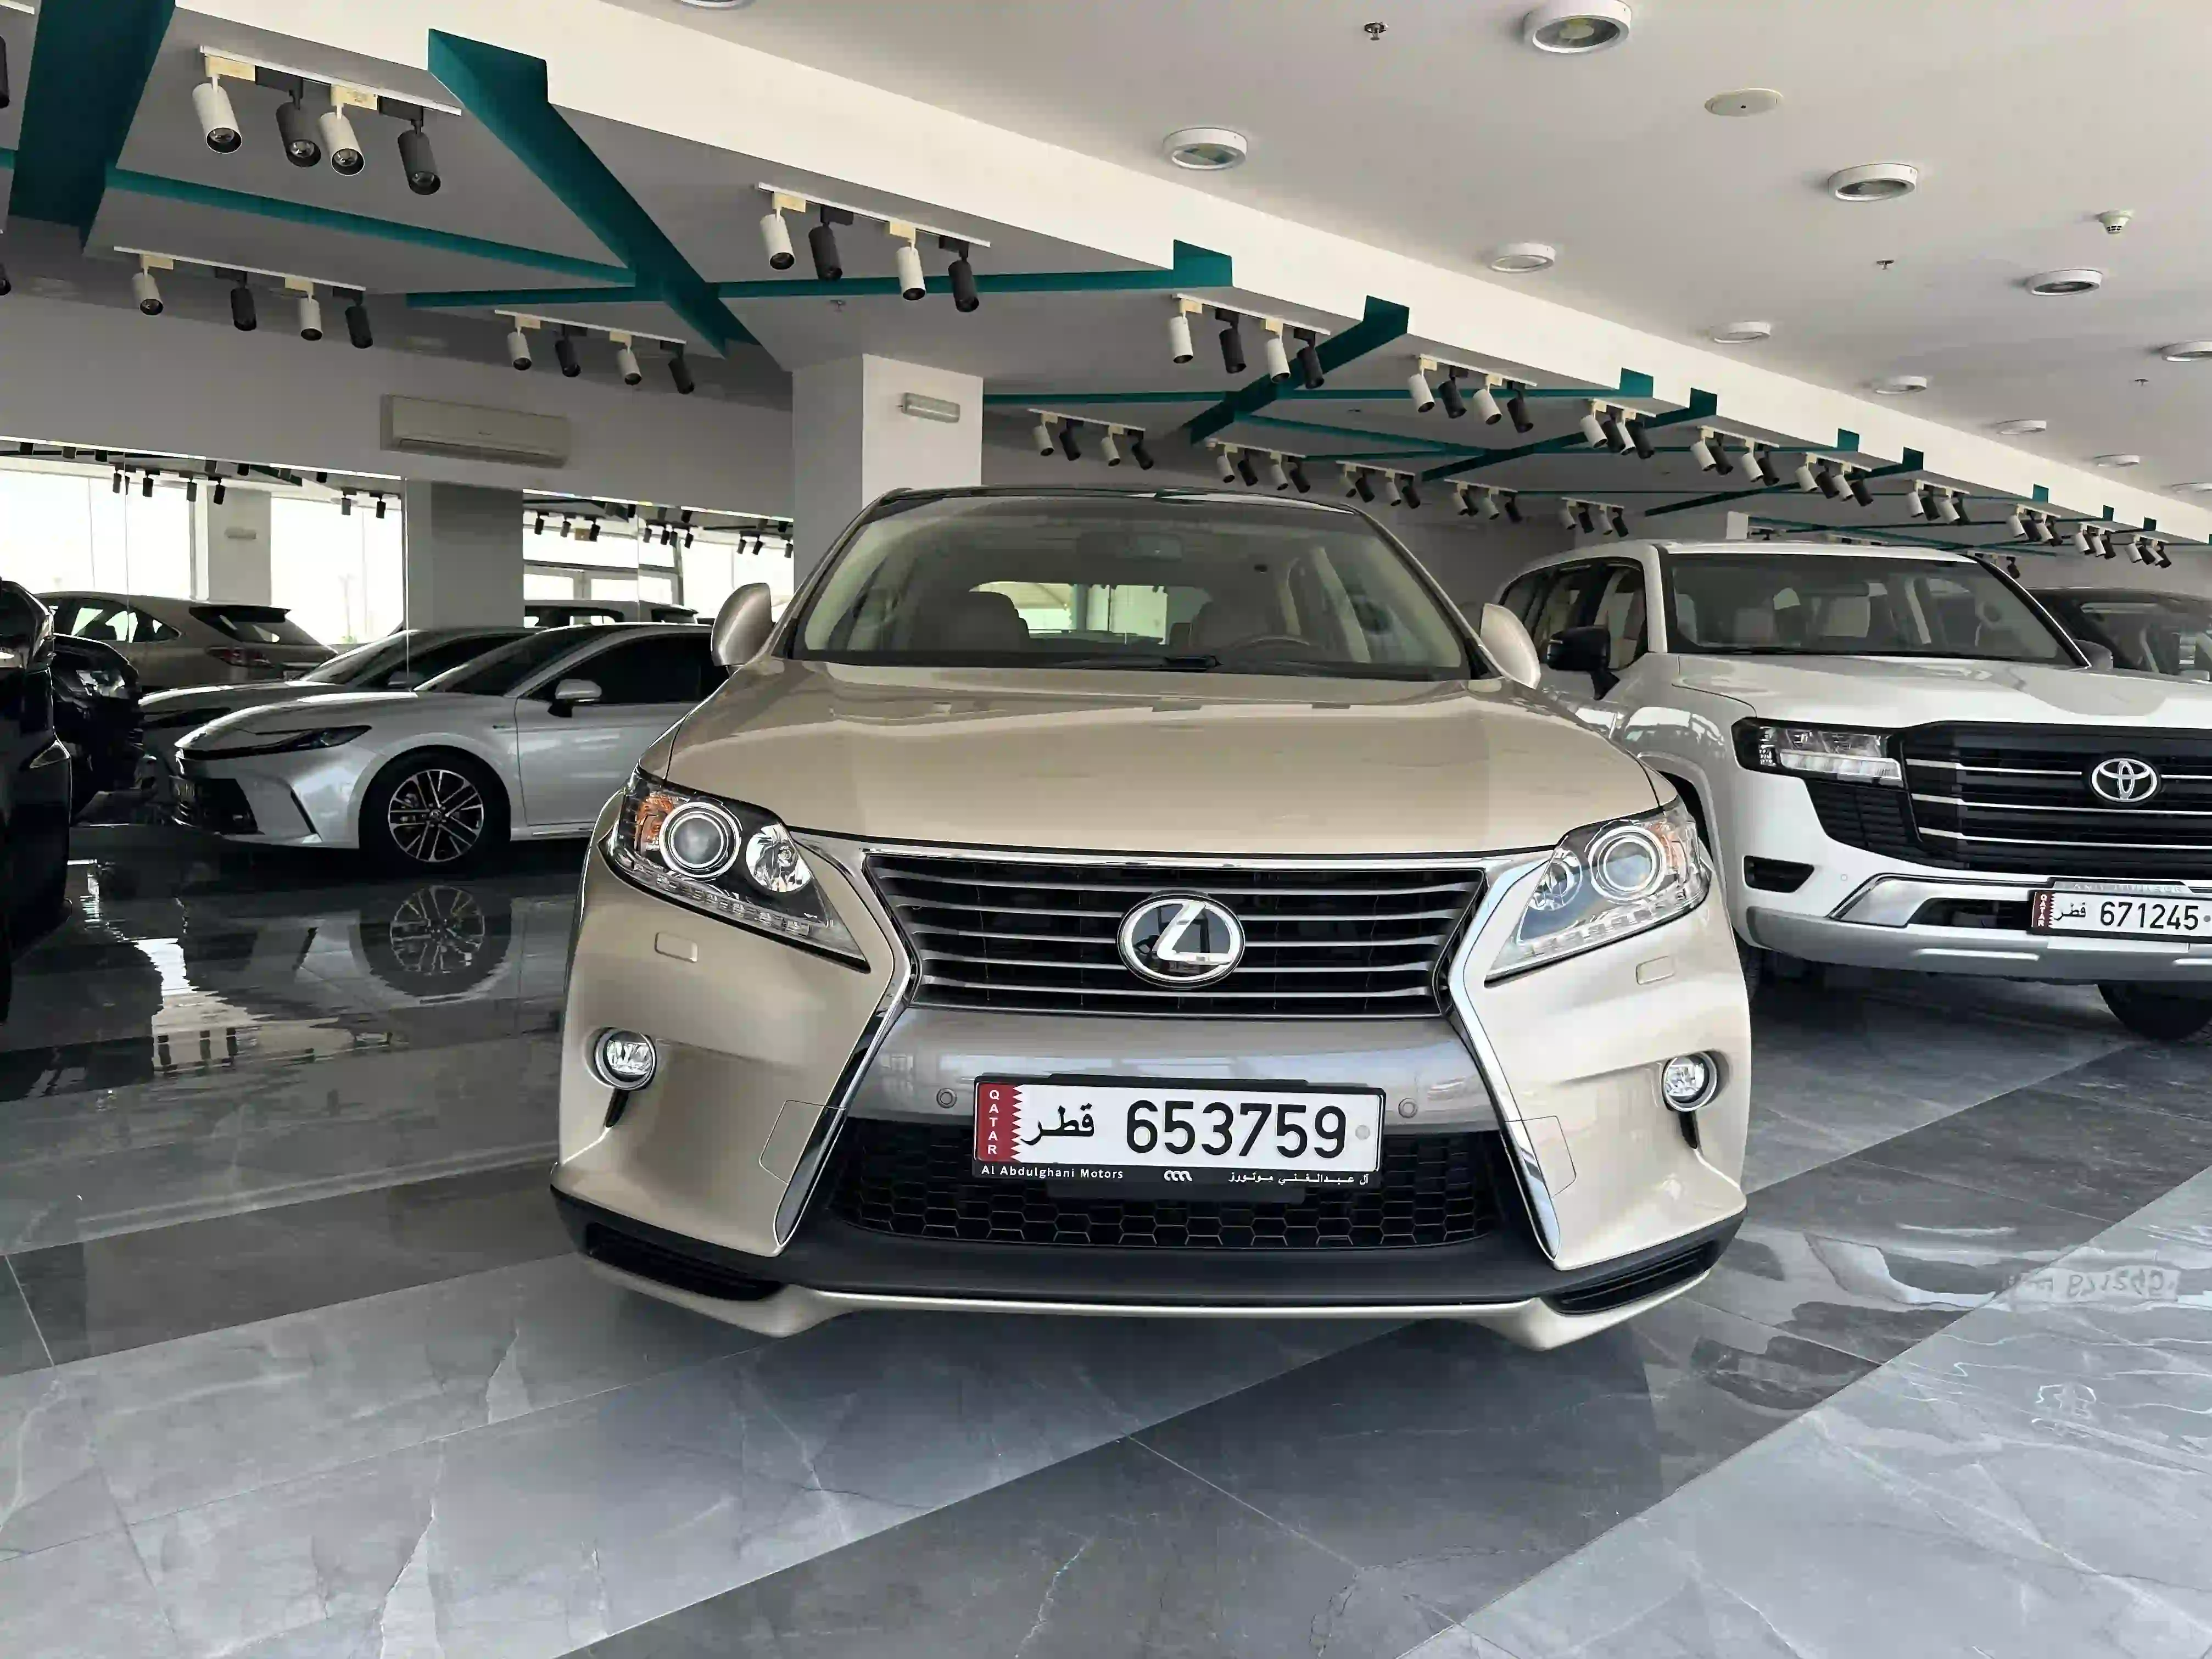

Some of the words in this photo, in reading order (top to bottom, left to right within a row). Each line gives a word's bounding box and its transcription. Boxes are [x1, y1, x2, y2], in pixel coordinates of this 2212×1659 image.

[2038, 894, 2047, 926] QATAR
[2053, 901, 2086, 921] قطر
[2100, 901, 2199, 931] 671245
[987, 1090, 999, 1154] QATAR
[1020, 1103, 1094, 1146] قطر
[1126, 1099, 1347, 1159] 653759
[981, 1165, 995, 1175] Al
[999, 1166, 1075, 1179] Abdulghani
[1080, 1169, 1123, 1178] Motors
